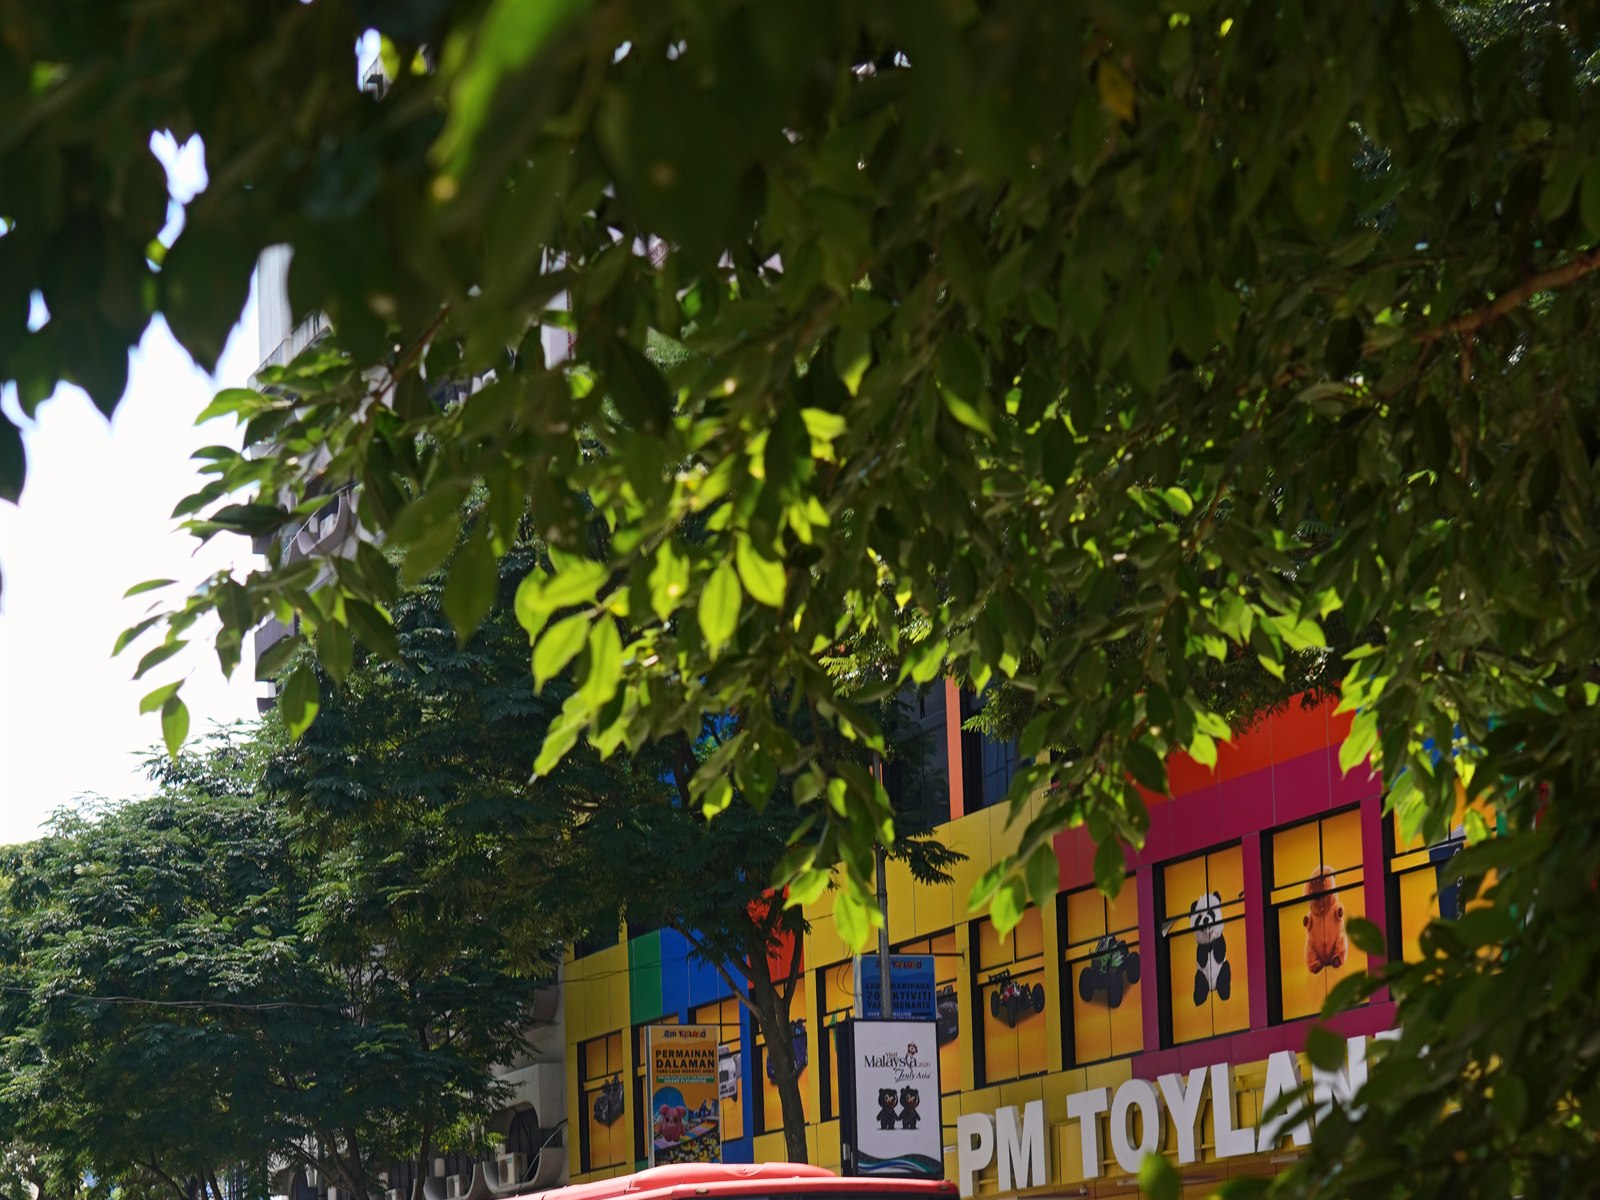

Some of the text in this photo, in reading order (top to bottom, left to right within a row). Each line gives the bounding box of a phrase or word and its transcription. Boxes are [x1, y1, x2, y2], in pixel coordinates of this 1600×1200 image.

[892, 991, 931, 1000] KTIVITI
[867, 1001, 881, 1009] YAN
[656, 1050, 714, 1058] PERMAINAN
[656, 1059, 714, 1068] DALAMAN
[864, 1054, 917, 1070] Malaysia
[915, 1071, 931, 1080] Asia
[957, 1028, 1403, 1198] PM TOYLAN
